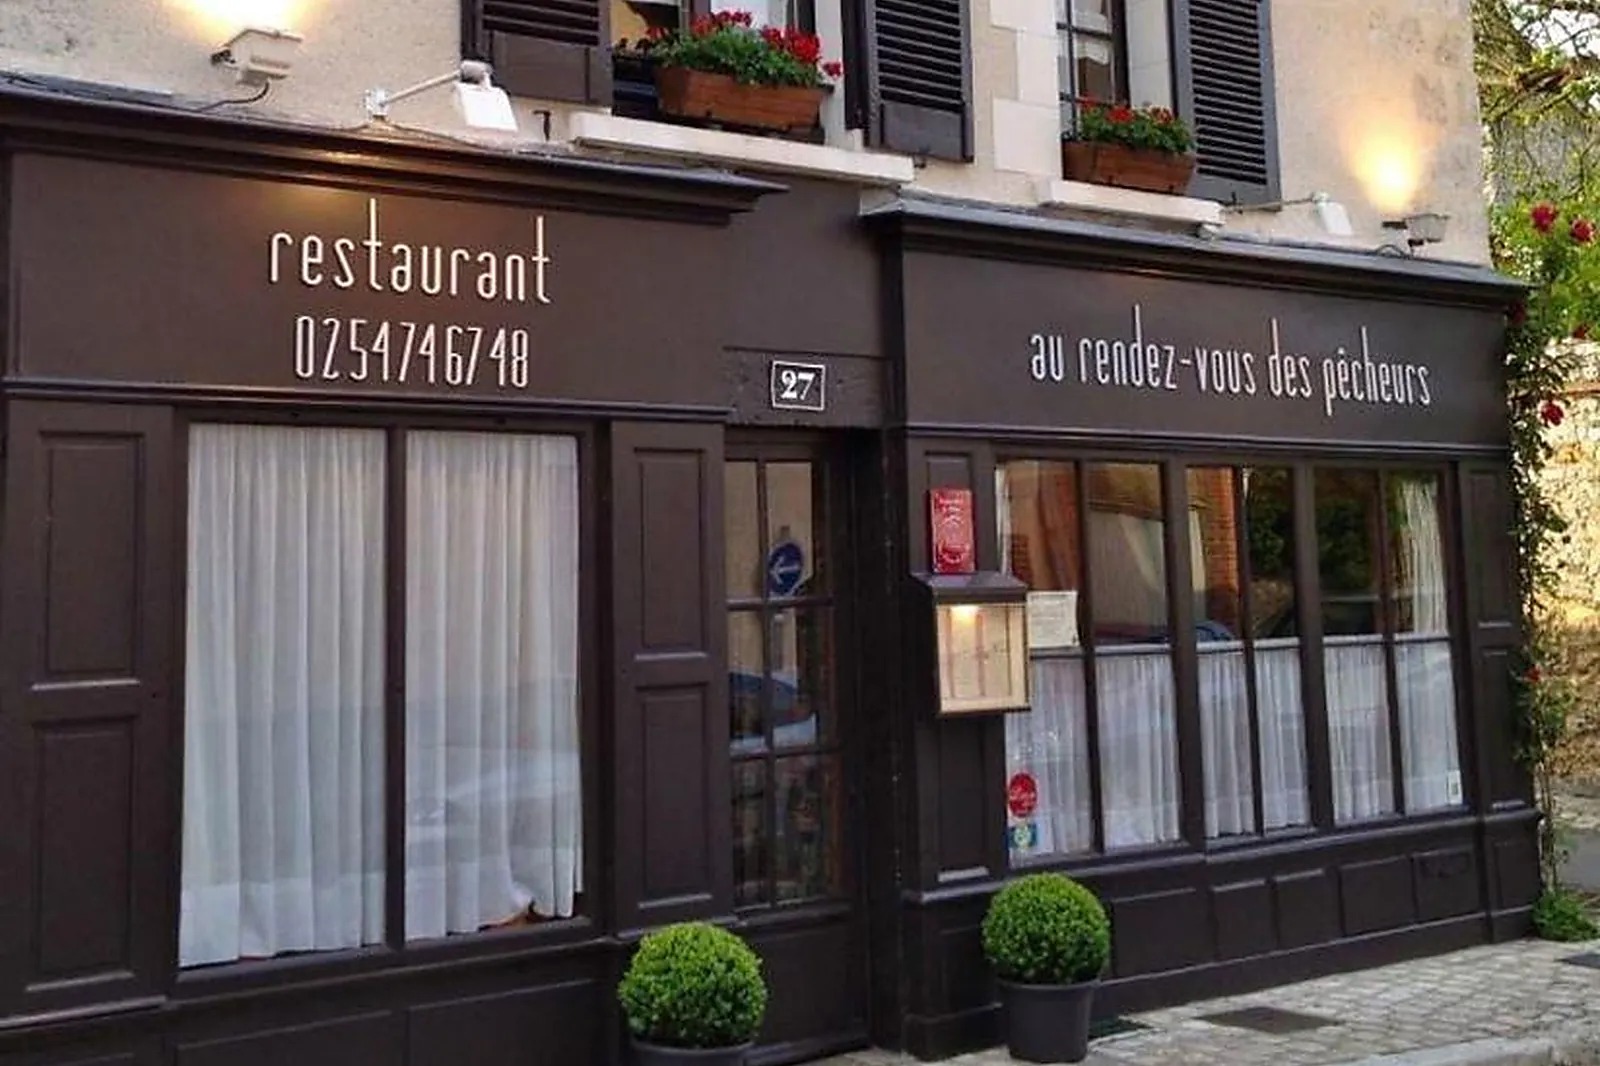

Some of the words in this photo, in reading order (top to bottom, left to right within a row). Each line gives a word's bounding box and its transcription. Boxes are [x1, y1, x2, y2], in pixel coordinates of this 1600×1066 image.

[269, 198, 551, 304] restaurant
[295, 315, 529, 388] 0254746748
[781, 370, 815, 400] 27
[1029, 333, 1064, 381] au
[1079, 303, 1256, 396] rendez-vous
[1269, 317, 1312, 399] des
[1323, 326, 1432, 416] pêcheurs
